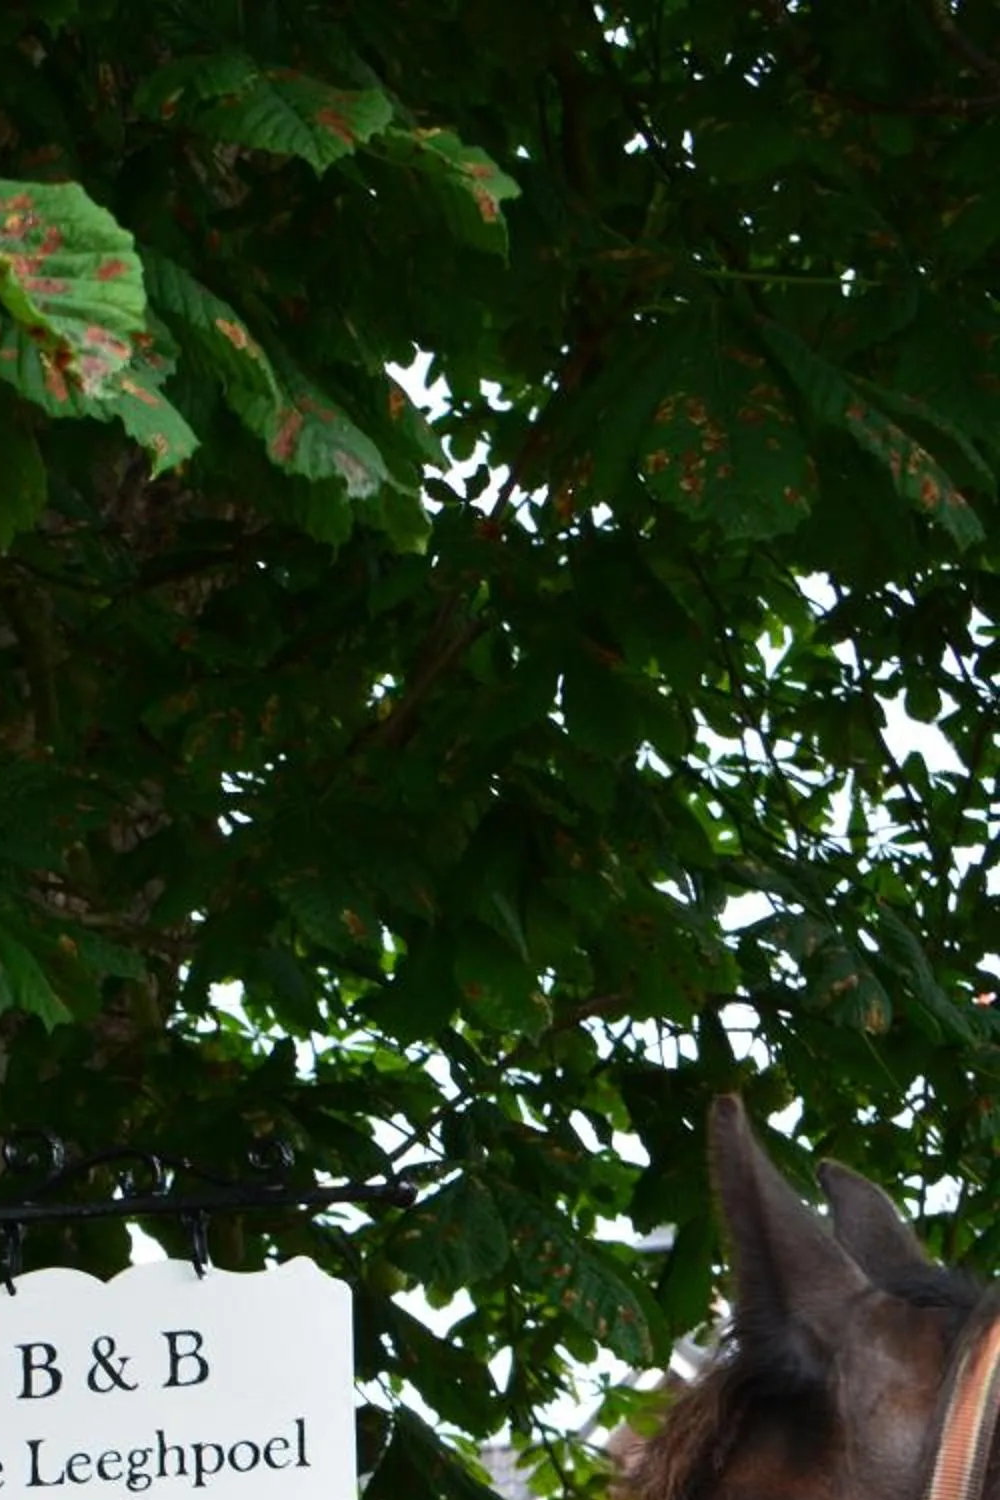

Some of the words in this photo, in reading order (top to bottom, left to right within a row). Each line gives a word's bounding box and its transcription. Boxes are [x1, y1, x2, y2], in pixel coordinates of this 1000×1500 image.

[15, 1342, 63, 1400] B
[87, 1335, 139, 1394] &
[162, 1329, 210, 1388] B
[26, 1418, 311, 1493] Leeghpoel
